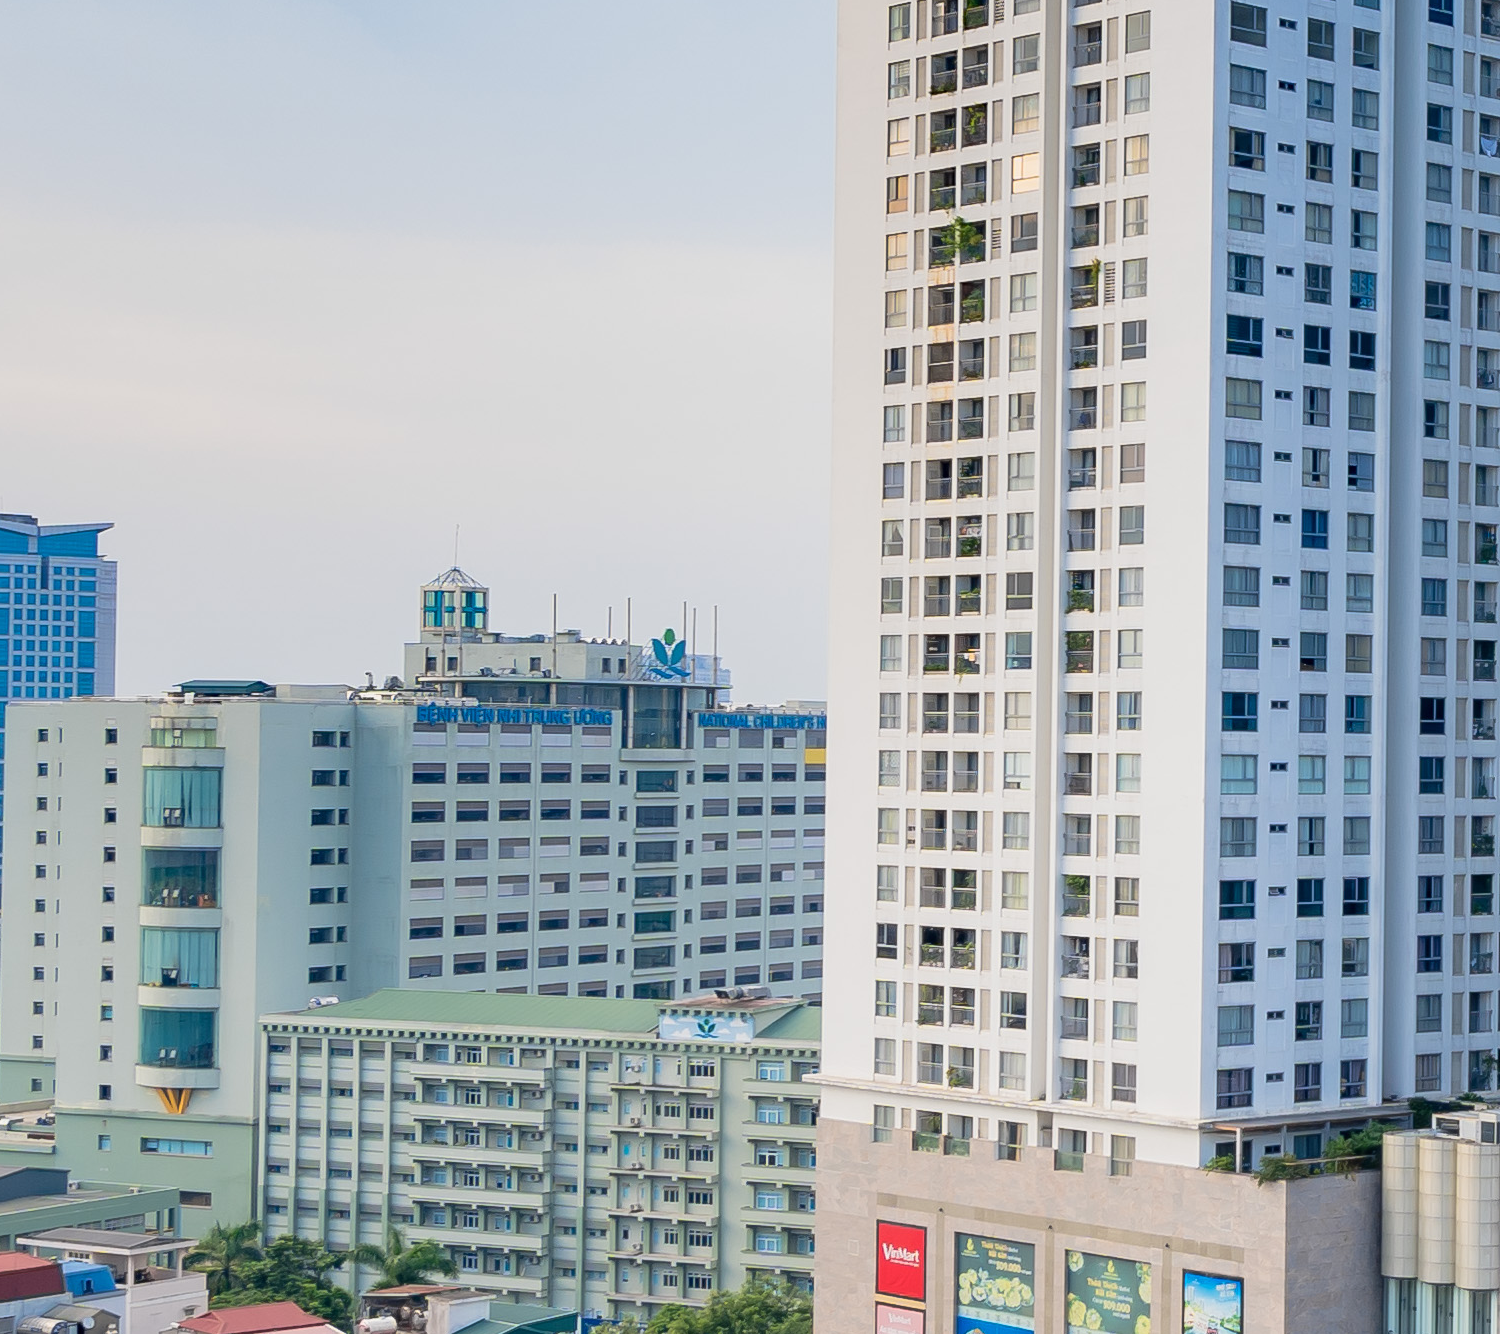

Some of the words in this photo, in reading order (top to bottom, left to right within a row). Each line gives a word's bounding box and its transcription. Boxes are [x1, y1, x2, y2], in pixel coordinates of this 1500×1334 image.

[417, 702, 458, 726] BỆNH
[461, 704, 495, 727] VIỆN
[498, 708, 522, 723] NHI
[524, 709, 572, 724] TRUNG
[699, 713, 748, 727] NATIONAL
[882, 1243, 920, 1263] VinMart
